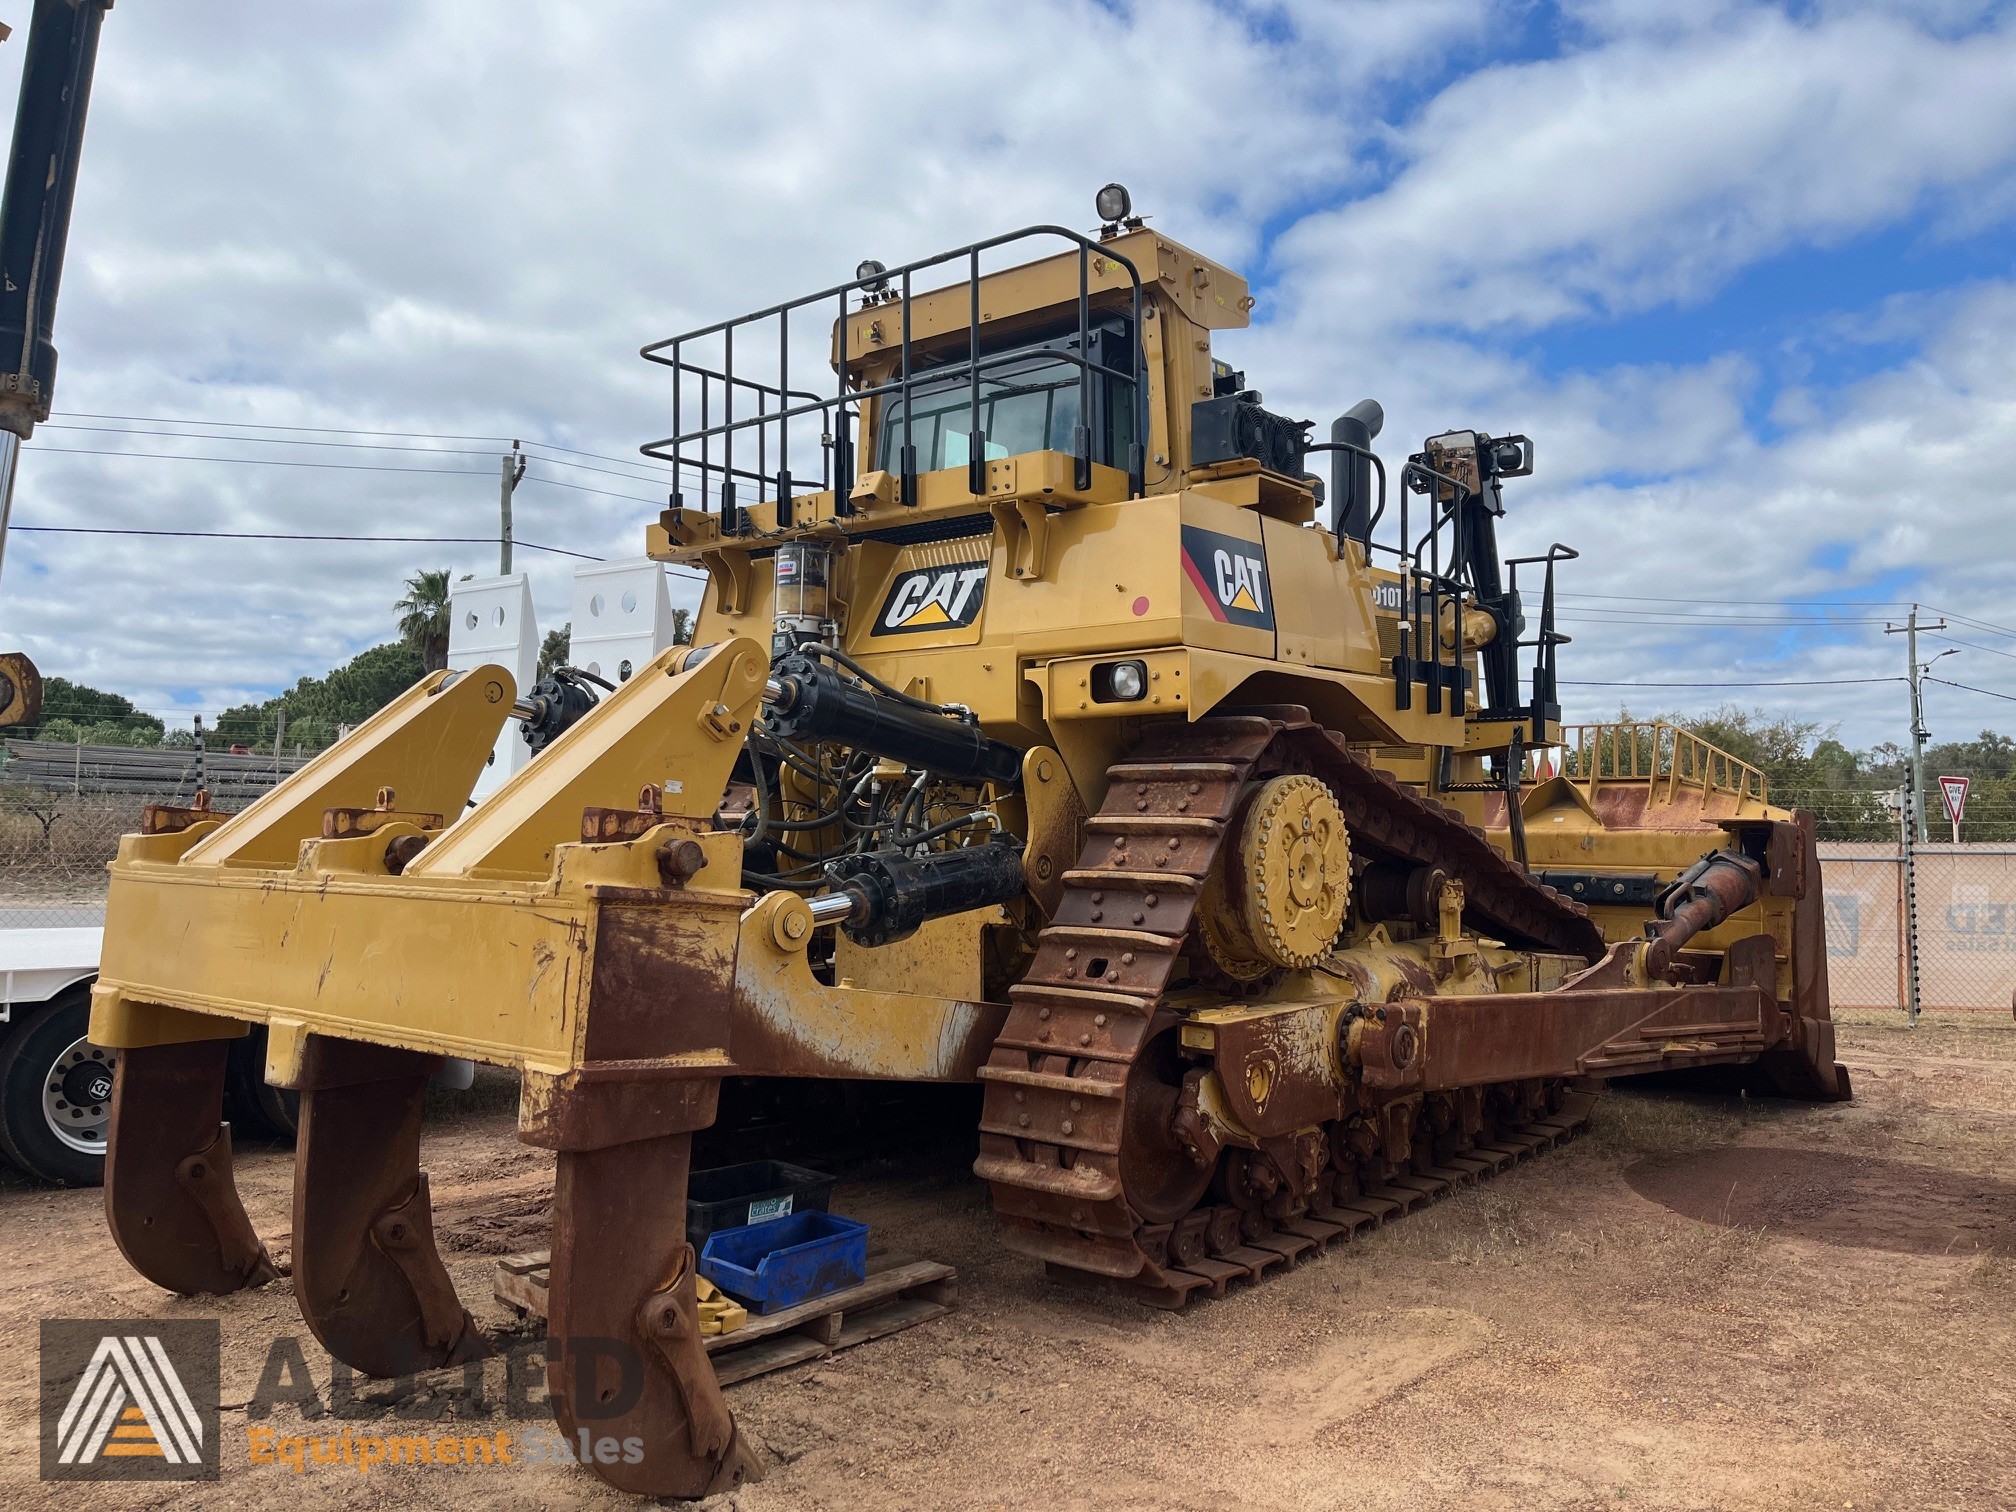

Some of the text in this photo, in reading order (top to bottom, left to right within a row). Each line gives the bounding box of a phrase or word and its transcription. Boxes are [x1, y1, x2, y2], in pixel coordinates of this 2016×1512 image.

[885, 567, 988, 628] CAT
[1213, 548, 1264, 614] CAT
[1949, 785, 1962, 795] GIVE
